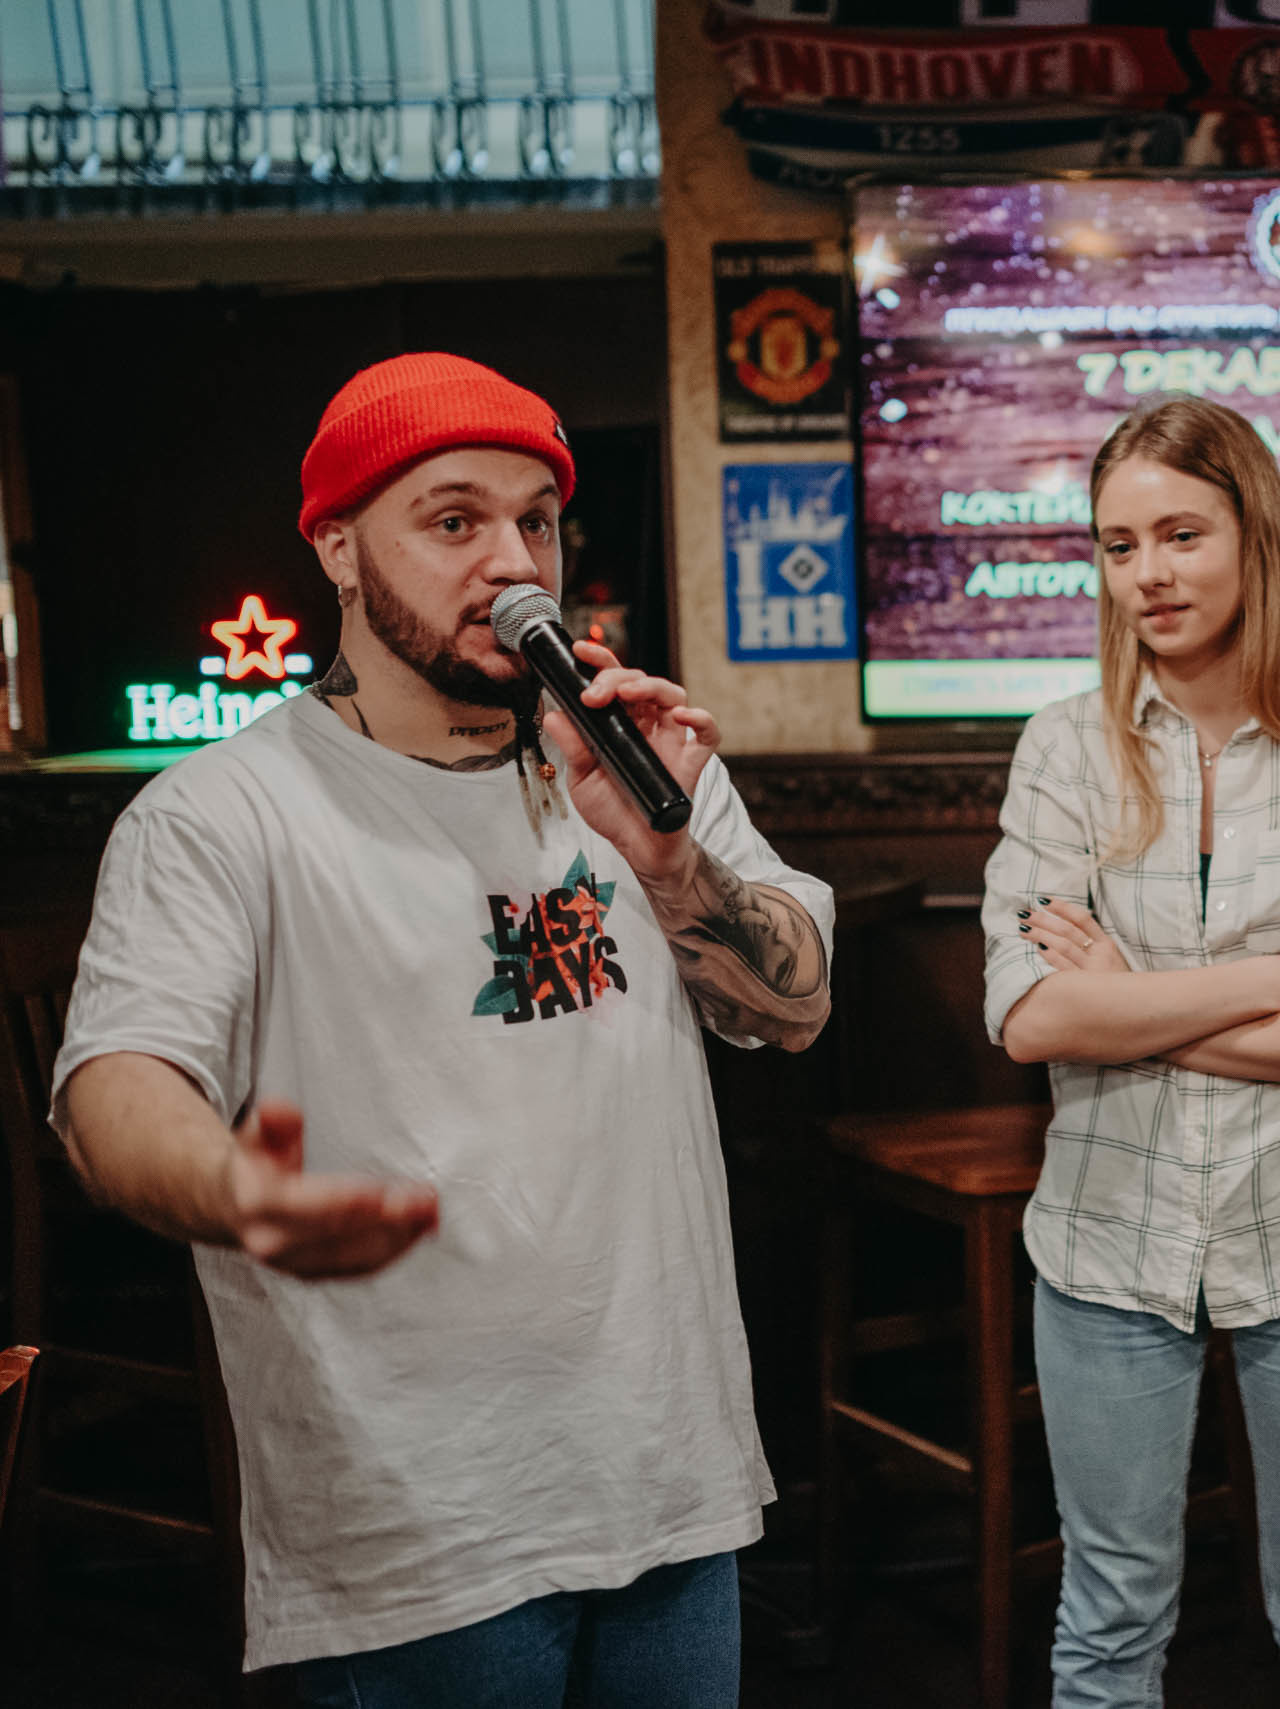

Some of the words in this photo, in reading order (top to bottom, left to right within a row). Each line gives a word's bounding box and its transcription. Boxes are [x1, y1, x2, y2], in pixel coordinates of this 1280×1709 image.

[876, 126, 961, 152] 1255
[1077, 352, 1118, 397] 7
[493, 936, 628, 1025] DAYS
